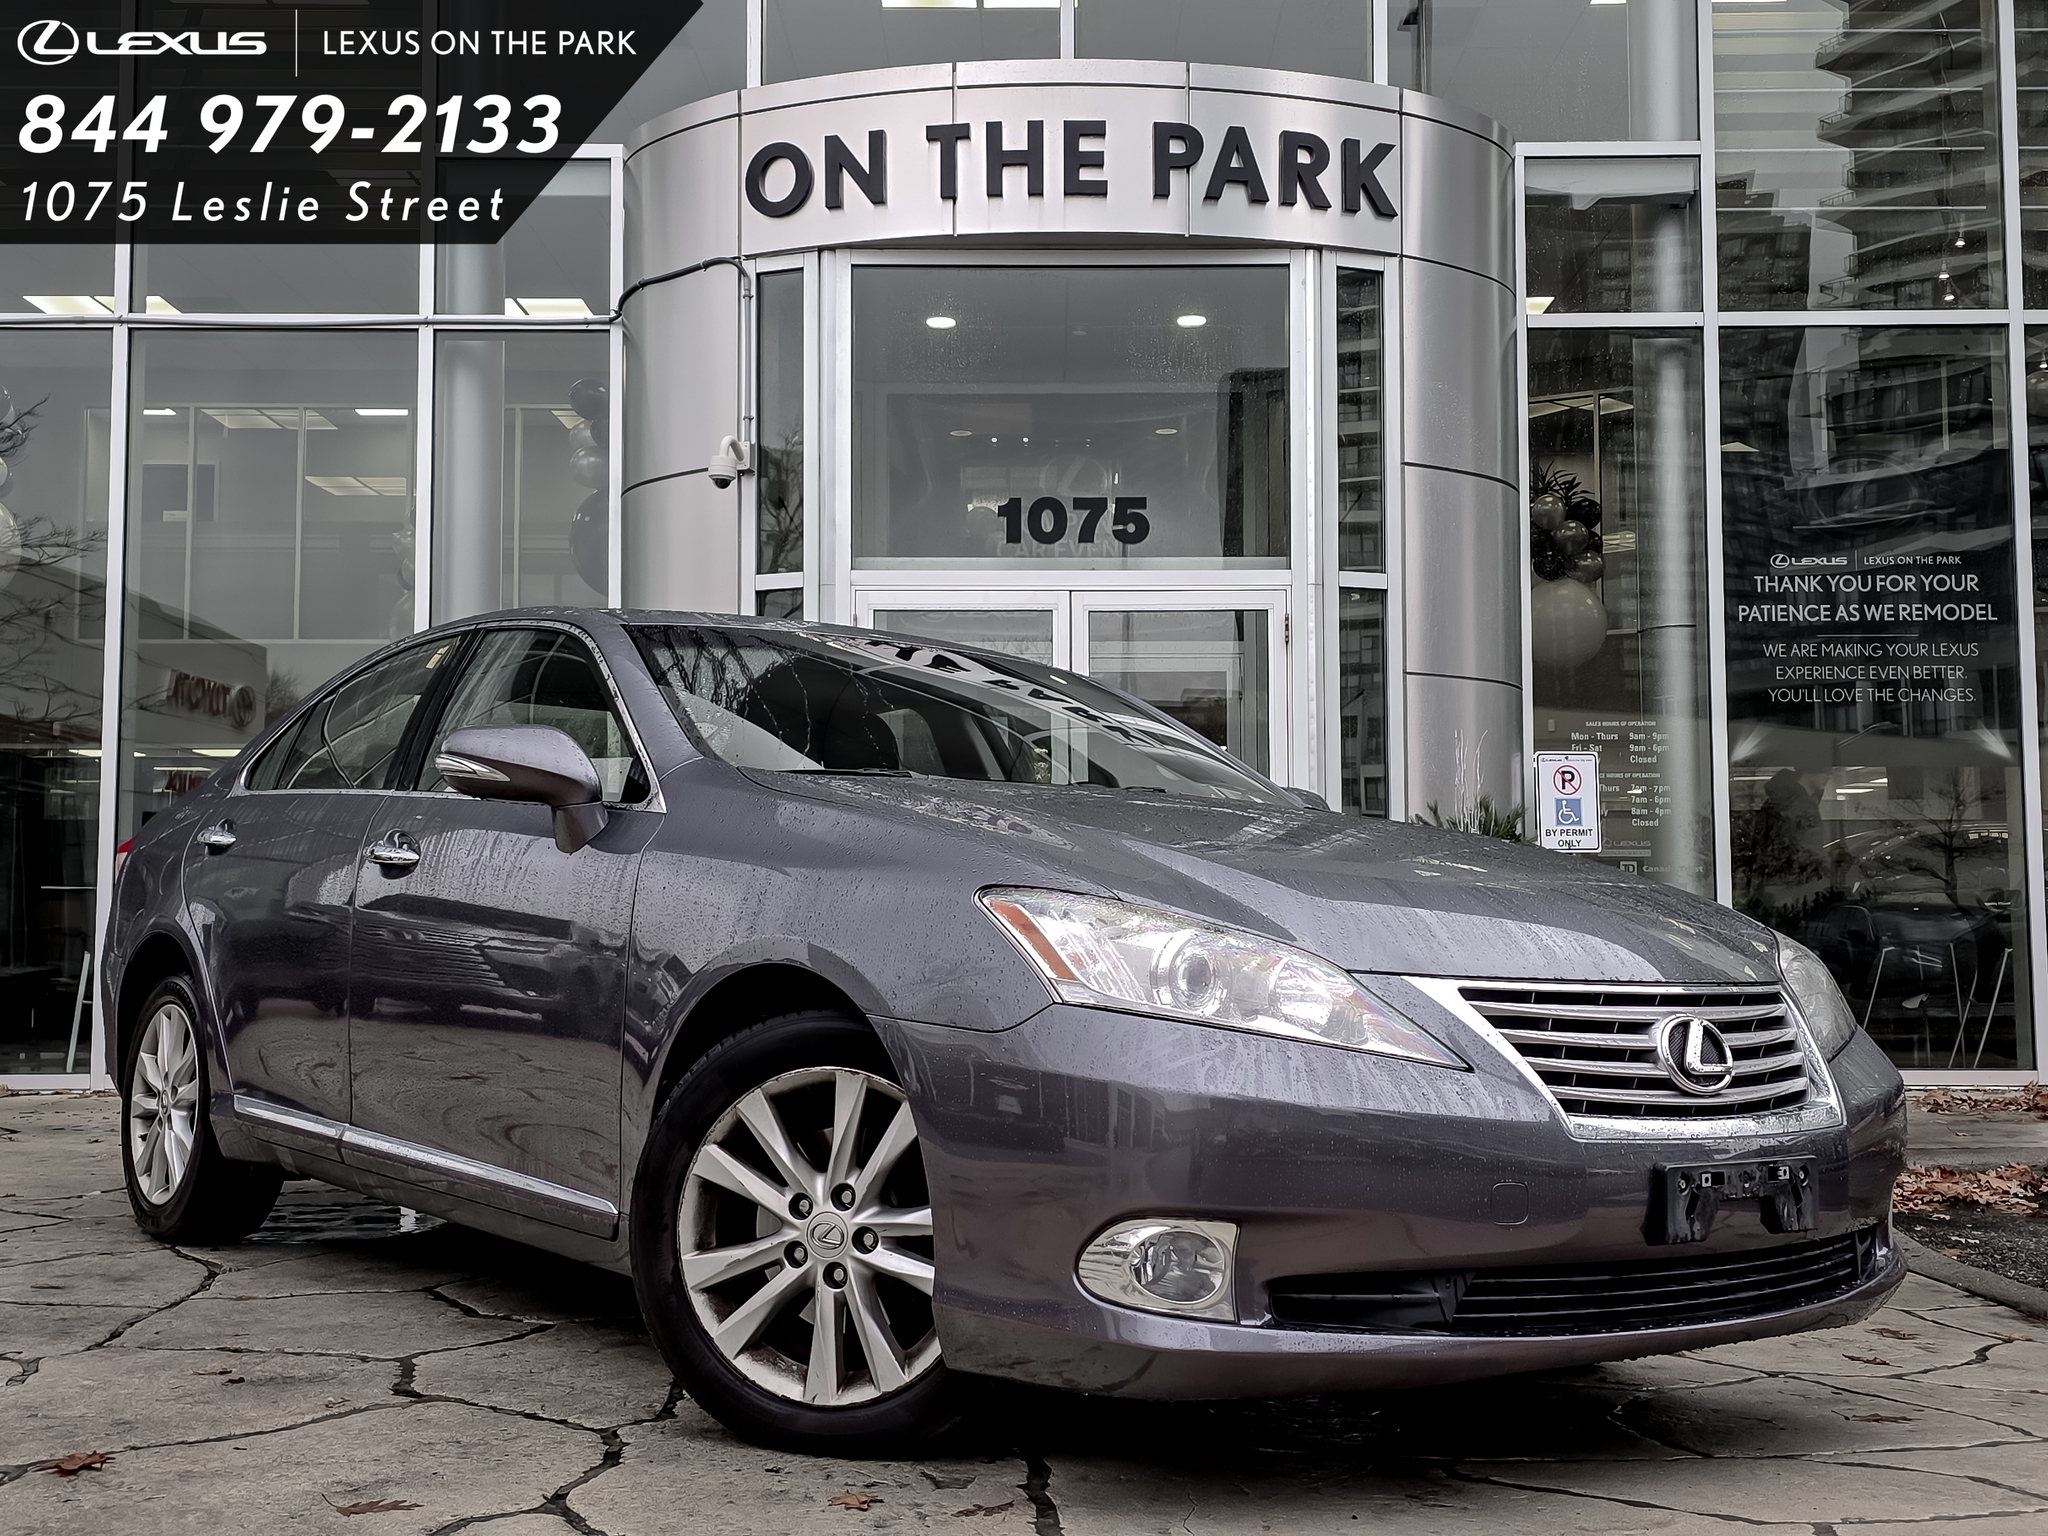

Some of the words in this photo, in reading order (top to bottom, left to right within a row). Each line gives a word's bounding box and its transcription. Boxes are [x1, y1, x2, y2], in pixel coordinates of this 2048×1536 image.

[745, 129, 887, 219] ON
[925, 119, 1108, 202] THE
[1151, 121, 1399, 220] PARK
[997, 496, 1150, 545] 1075
[1791, 557, 1848, 565] LEXUS
[1864, 556, 1895, 565] LEXUS
[1897, 556, 1914, 565] ON
[1916, 556, 1934, 565] THE
[1936, 556, 1962, 565] PARK
[1754, 575, 1822, 592] THANK
[1827, 575, 1872, 592] YOU
[1877, 575, 1917, 592] FOR
[1921, 574, 1979, 592] YOUR
[1738, 605, 1831, 622] PATIENCE
[1835, 605, 1860, 621] AS
[1865, 605, 1894, 621] WE
[1900, 604, 1998, 621] REMODEL
[1763, 644, 1787, 657] WE
[1791, 644, 1818, 657] ARE
[1822, 643, 1883, 657] MAKING
[1886, 643, 1928, 657] YOUR
[1932, 643, 1979, 657] LEXUS
[1776, 666, 1866, 680] EXPERIENCE
[1870, 666, 1909, 679] EVEN
[1914, 665, 1968, 679] BETTER.
[1768, 688, 1821, 702] YOU'LL
[1824, 688, 1863, 702] LOVE
[1867, 688, 1894, 701] THE
[1898, 688, 1977, 702] CHANGES.
[1571, 732, 1589, 740] Mon
[1596, 732, 1618, 740] Thurs
[1629, 732, 1646, 740] 9am
[1652, 732, 1669, 741] 9pm
[1589, 744, 1602, 752] Sat
[1629, 744, 1646, 752] 9am
[1653, 744, 1670, 753] 6pm
[1630, 755, 1657, 763] Closed
[1653, 784, 1670, 793] 7pm
[1654, 796, 1671, 805] 6pm
[1654, 807, 1671, 816] 4pm
[1632, 818, 1659, 826] Closed
[1558, 839, 1582, 847] ONLY
